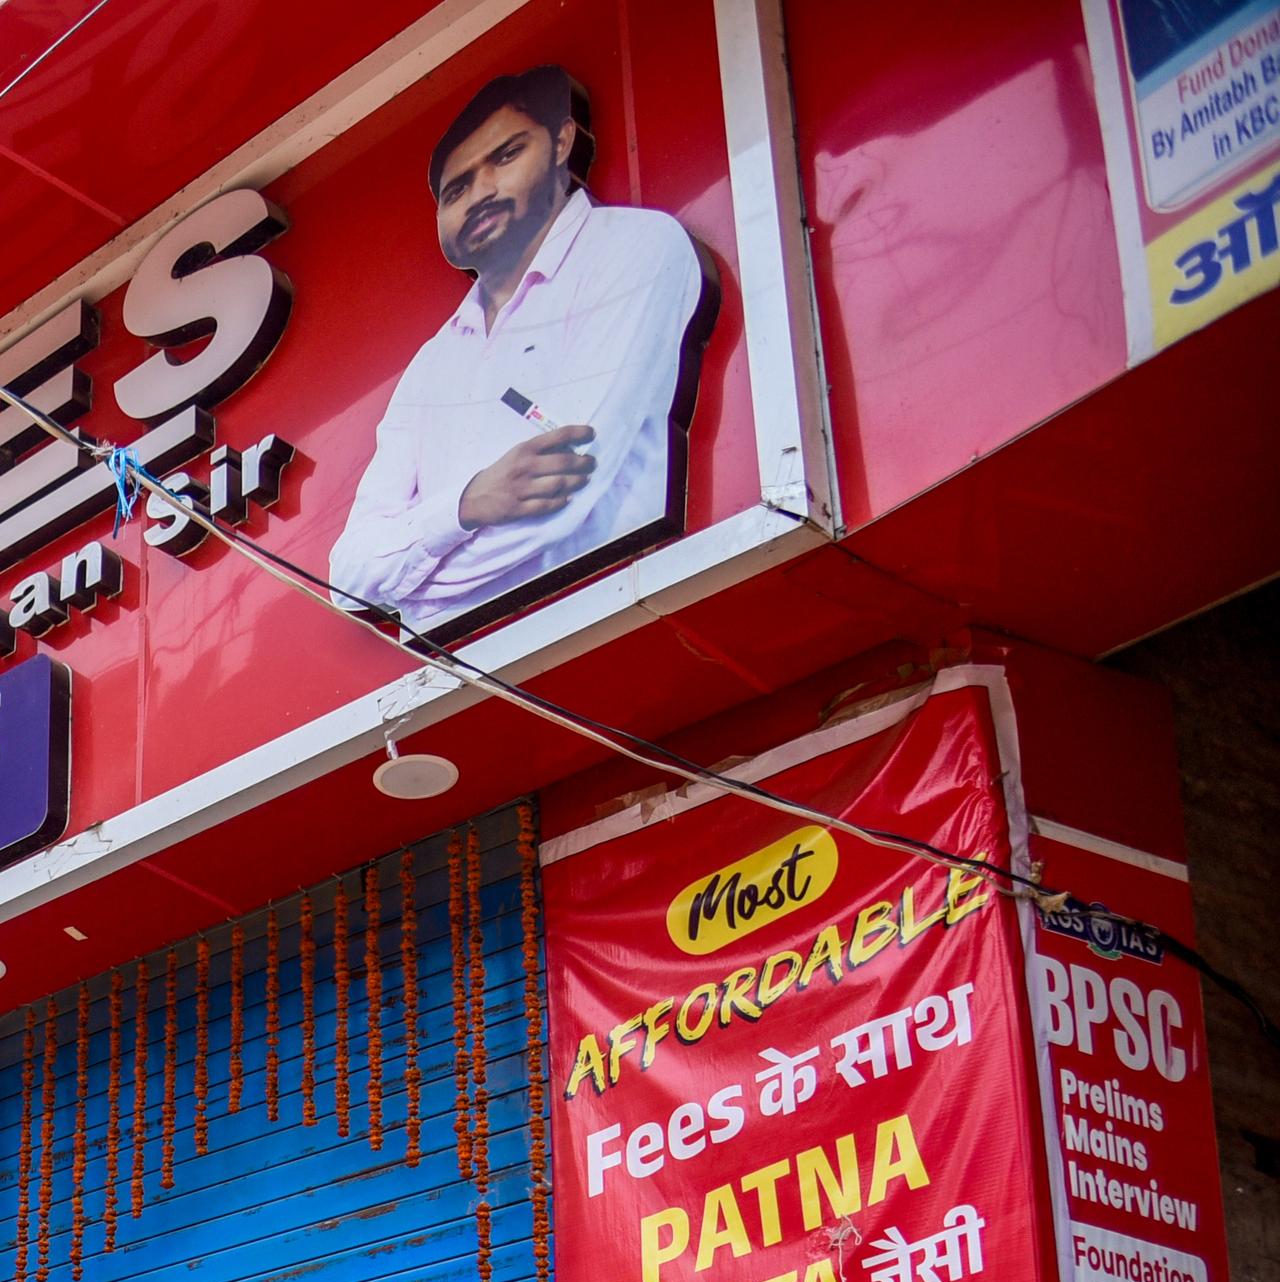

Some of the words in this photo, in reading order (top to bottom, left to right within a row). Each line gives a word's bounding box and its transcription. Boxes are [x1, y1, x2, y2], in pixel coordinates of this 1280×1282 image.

[1176, 54, 1225, 102] Fund
[1228, 10, 1280, 68] Dona
[1151, 128, 1175, 160] By
[1180, 71, 1257, 141] Amitabh
[1213, 132, 1232, 160] in
[687, 844, 814, 941] Most
[564, 852, 990, 1101] AFFORDABLE
[1034, 953, 1187, 1083] BPSC
[586, 1084, 744, 1198] Fees
[754, 1048, 821, 1117] के
[831, 982, 975, 1088] साथ
[1060, 1068, 1164, 1131] Prelims
[1064, 1114, 1148, 1171] Mains
[1068, 1160, 1196, 1232] Interview
